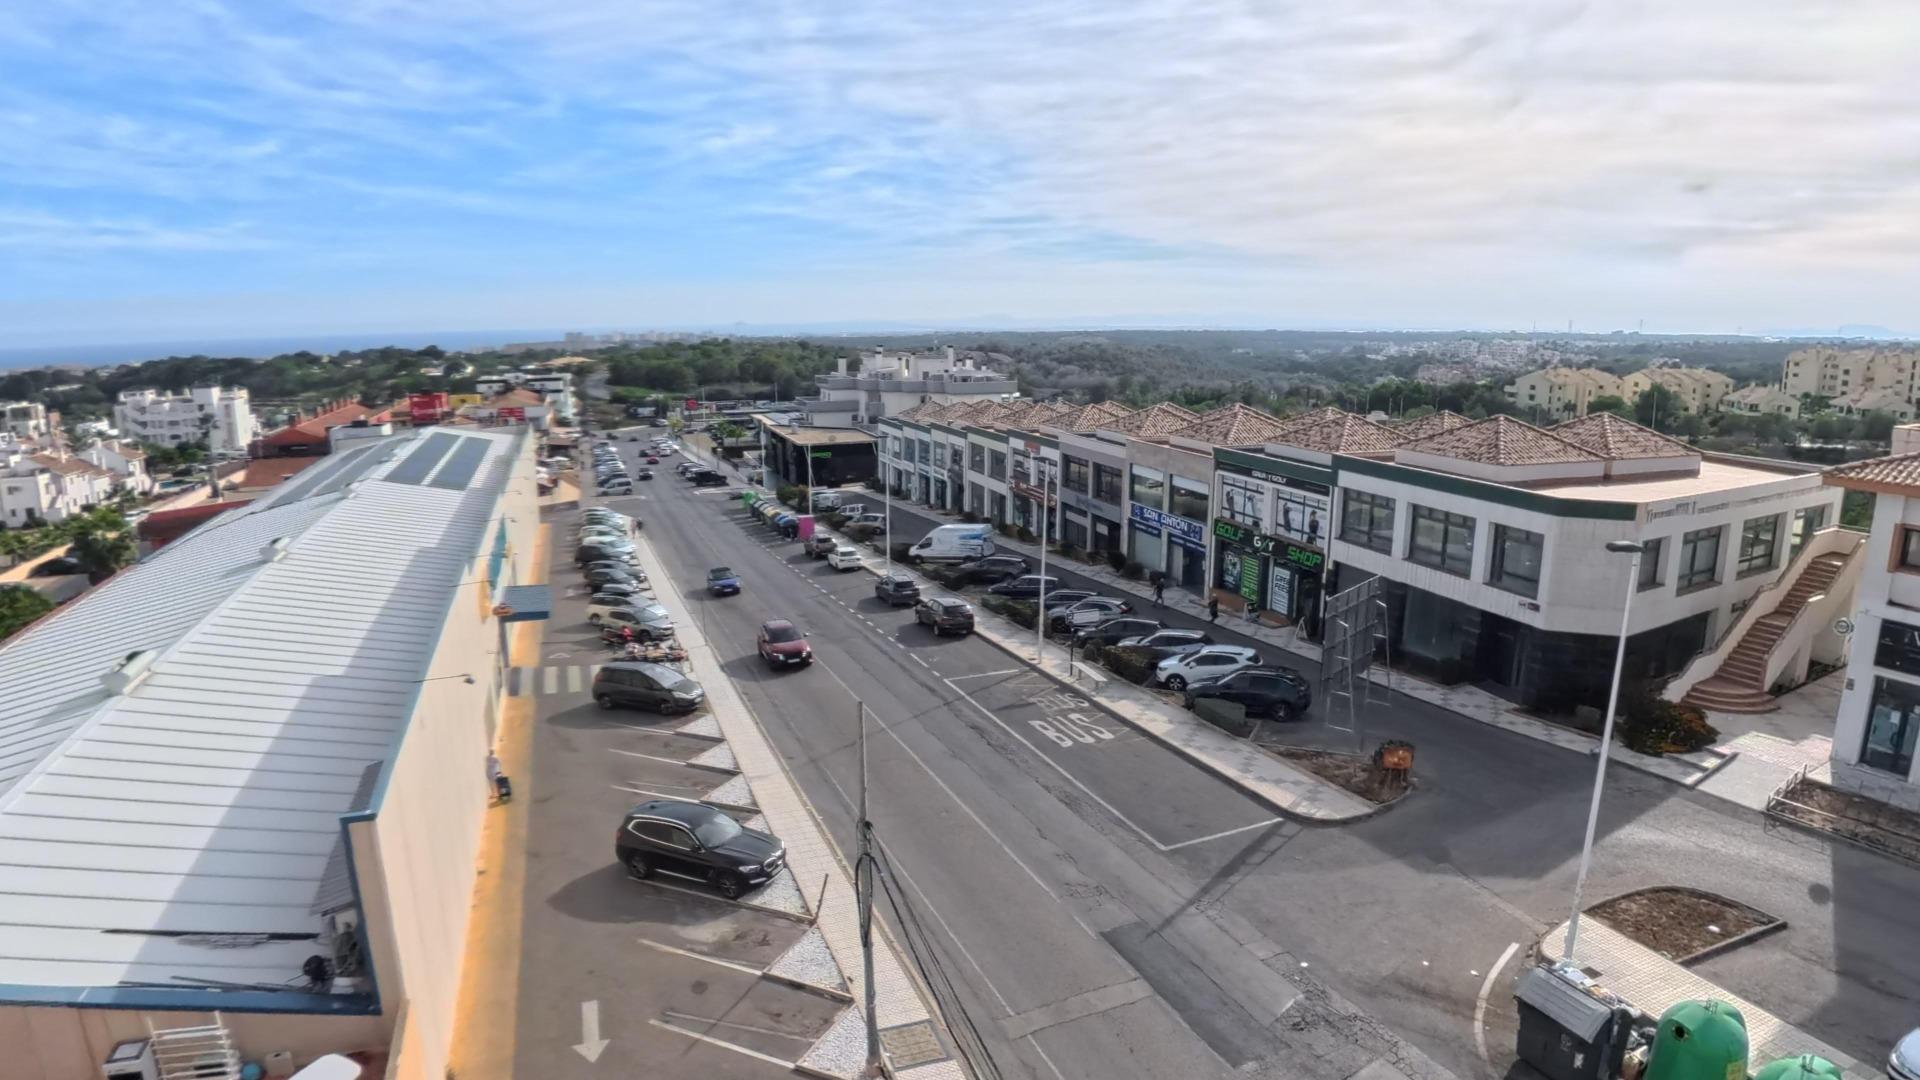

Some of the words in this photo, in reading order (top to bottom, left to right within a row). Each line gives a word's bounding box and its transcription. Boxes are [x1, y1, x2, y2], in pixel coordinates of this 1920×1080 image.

[1143, 508, 1159, 521] SAN
[1216, 523, 1245, 541] GOLF
[1287, 545, 1322, 567] SHOP
[1028, 713, 1115, 748] BUS
